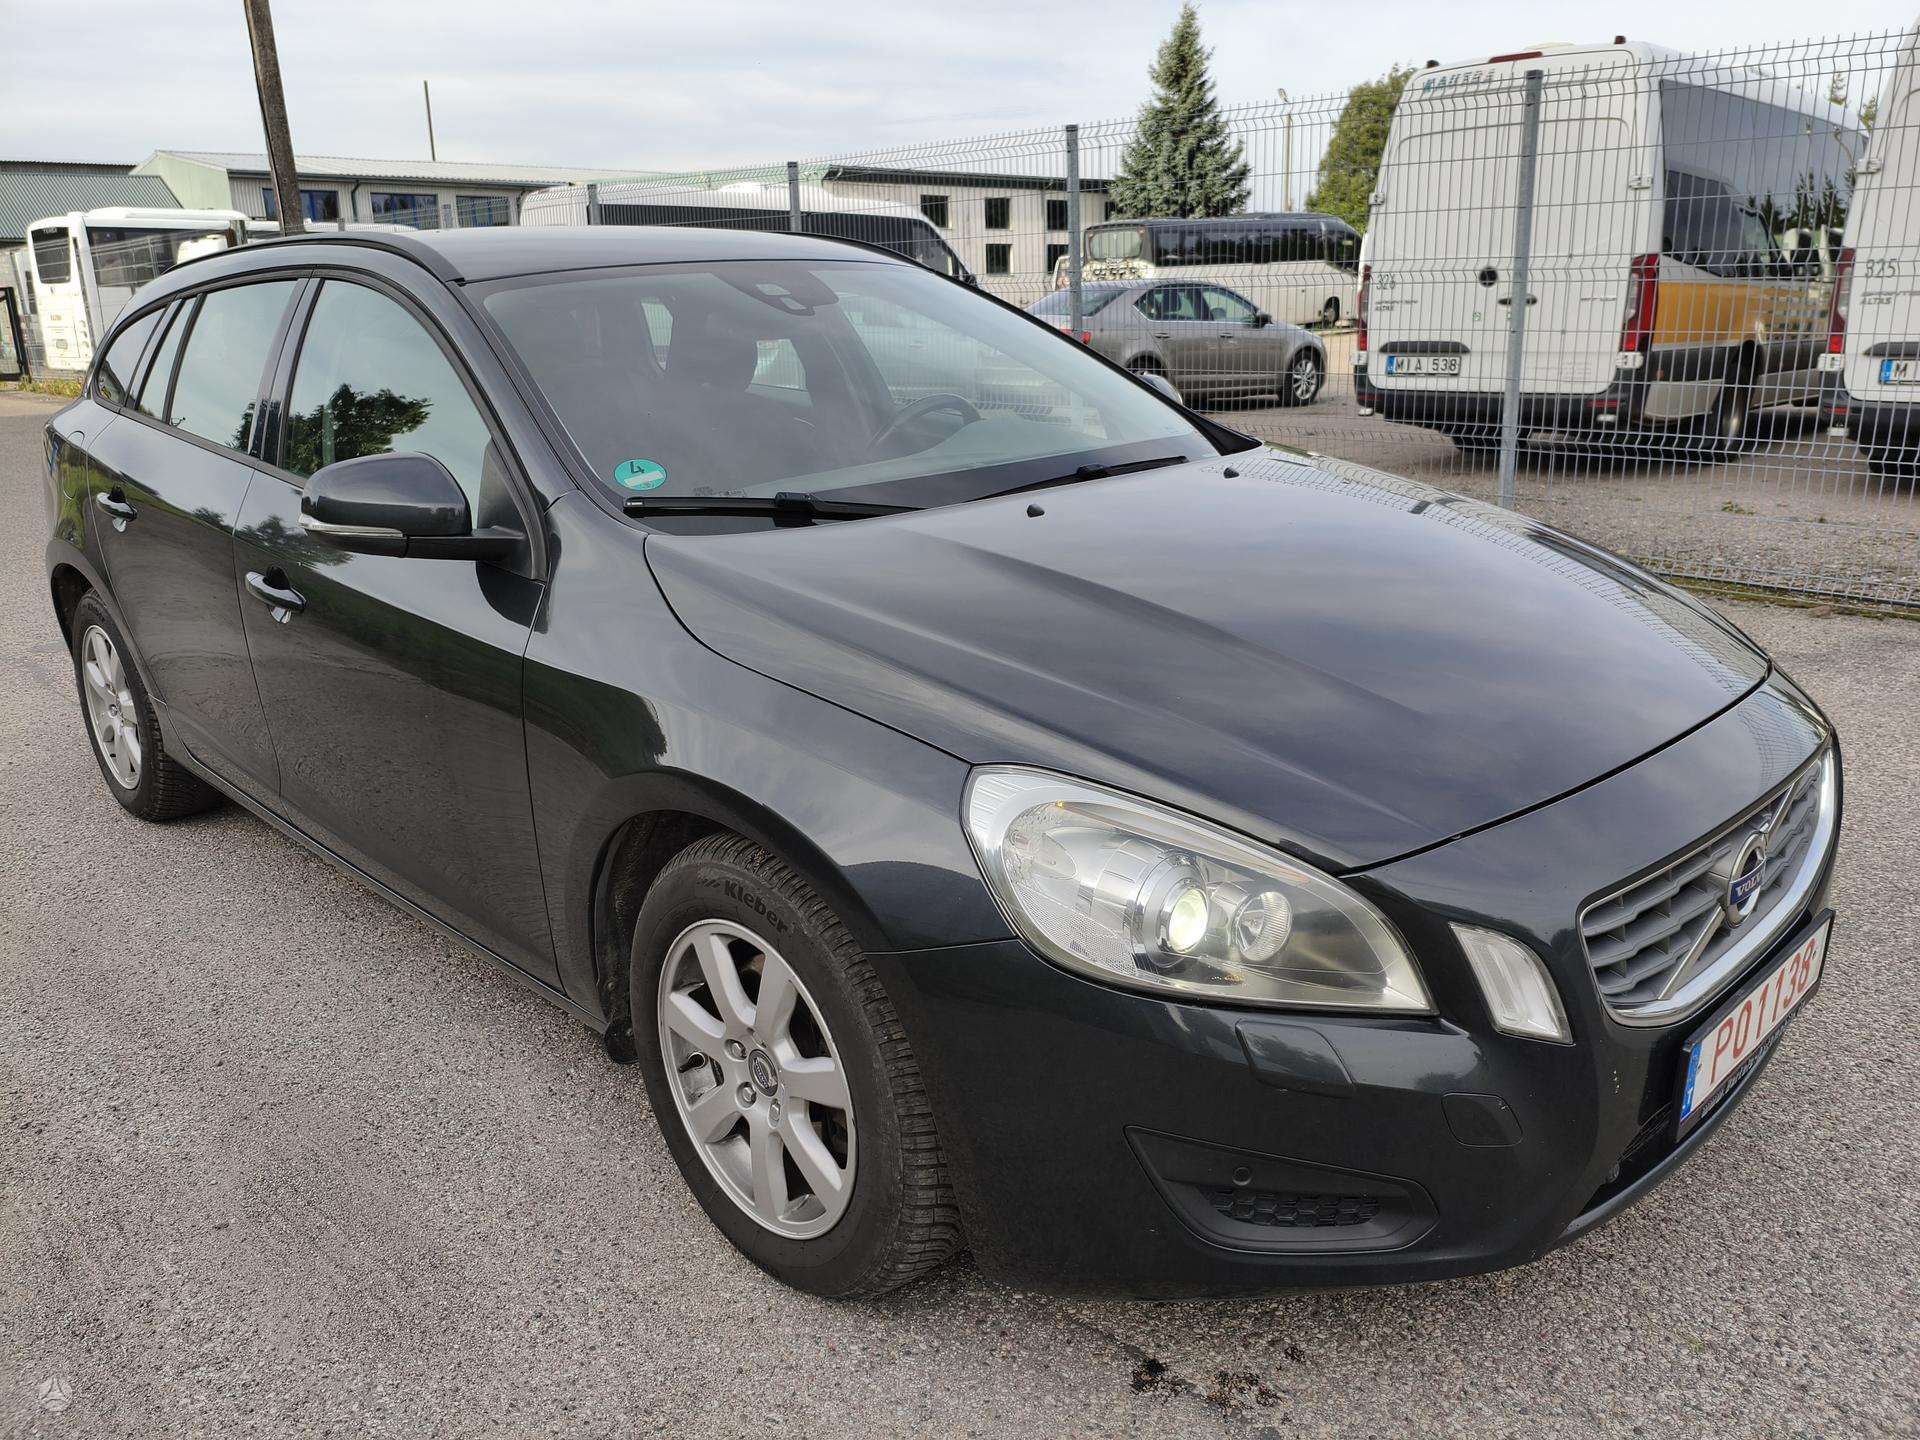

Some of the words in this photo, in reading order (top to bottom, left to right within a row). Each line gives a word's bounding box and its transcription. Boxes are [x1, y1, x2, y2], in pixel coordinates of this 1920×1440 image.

[1395, 358, 1422, 372] MIA
[1432, 358, 1457, 371] 538
[629, 460, 645, 474] 4
[1735, 872, 1761, 896] VOLV
[724, 879, 788, 933] Kleber
